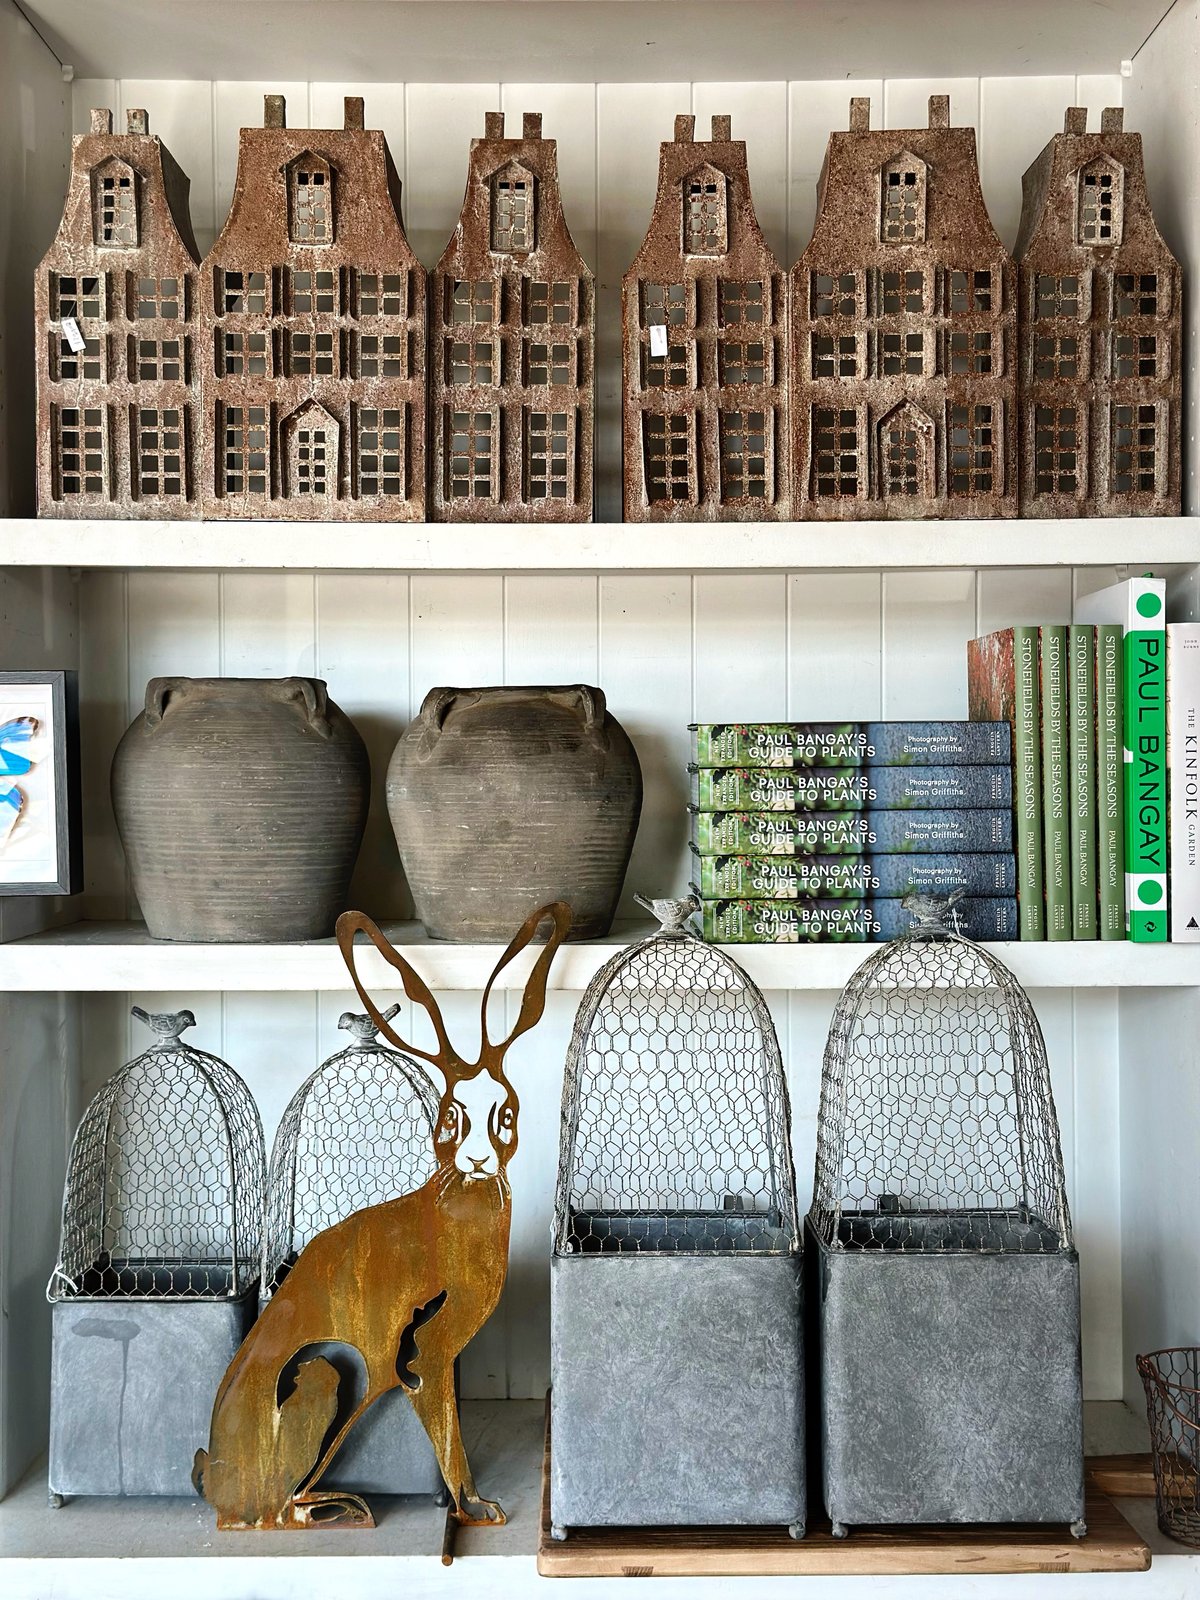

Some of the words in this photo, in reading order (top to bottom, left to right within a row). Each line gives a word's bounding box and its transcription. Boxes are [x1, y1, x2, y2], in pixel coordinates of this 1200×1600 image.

[1022, 638, 1033, 718] STONEFIELDS
[1050, 637, 1060, 717] STONEFIELDS
[1077, 636, 1087, 716] STONEFIELDS
[1105, 636, 1116, 716] STONEFIELDS
[1138, 639, 1159, 722] PAUL
[1023, 721, 1033, 735] BY
[1051, 720, 1060, 734] BY
[1078, 720, 1088, 733] BY
[1106, 720, 1116, 733] BY
[757, 734, 792, 746] PAUL
[797, 734, 867, 745] BANGAY'S
[908, 736, 946, 744] Photography
[749, 746, 793, 758] GUIDE
[798, 746, 816, 758] TO
[821, 746, 875, 757] PLANTS
[903, 745, 928, 753] Simon
[930, 744, 962, 753] Griffiths
[1024, 738, 1033, 762] THE
[1051, 737, 1061, 761] THE
[1078, 736, 1087, 760] THE
[1107, 736, 1116, 761] THE
[759, 777, 793, 789] PAUL
[798, 777, 868, 788] BANGAY'S
[909, 779, 948, 787] Photography
[951, 779, 959, 787] by
[1185, 736, 1197, 820] KINFOLK
[750, 789, 794, 801] GUIDE
[800, 789, 817, 801] TO
[823, 789, 877, 800] PLANTS
[905, 788, 930, 796] Simon
[932, 787, 964, 796] Griffiths
[1024, 765, 1035, 818] SEASONS
[1052, 764, 1062, 818] SEASONS
[1078, 763, 1088, 817] SEASONS
[1107, 763, 1117, 817] SEASONS
[1138, 736, 1160, 866] BANGAY
[759, 820, 793, 832] PAUL
[798, 820, 868, 831] BANGAY'S
[909, 822, 948, 830] Photography
[950, 822, 959, 830] by
[750, 832, 794, 844] GUIDE
[799, 832, 817, 844] TO
[823, 832, 877, 843] PLANTS
[905, 831, 930, 839] Simon
[932, 831, 963, 839] Griffiths
[762, 866, 796, 877] PAUL
[801, 865, 871, 877] BANGAY'S
[913, 867, 951, 876] Photography
[954, 867, 962, 875] by
[1027, 854, 1036, 888] BANGAY
[1080, 852, 1088, 886] BANGAY
[1109, 853, 1117, 887] BANGAY
[753, 877, 797, 889] GUIDE
[802, 877, 820, 889] TO
[826, 877, 880, 889] PLANTS
[908, 876, 933, 885] Simon
[935, 876, 967, 885] Griffiths
[763, 910, 797, 921] PAUL
[802, 909, 872, 921] BANGAY'S
[754, 921, 798, 933] GUIDE
[803, 922, 821, 933] TO
[827, 921, 881, 933] PLANTS
